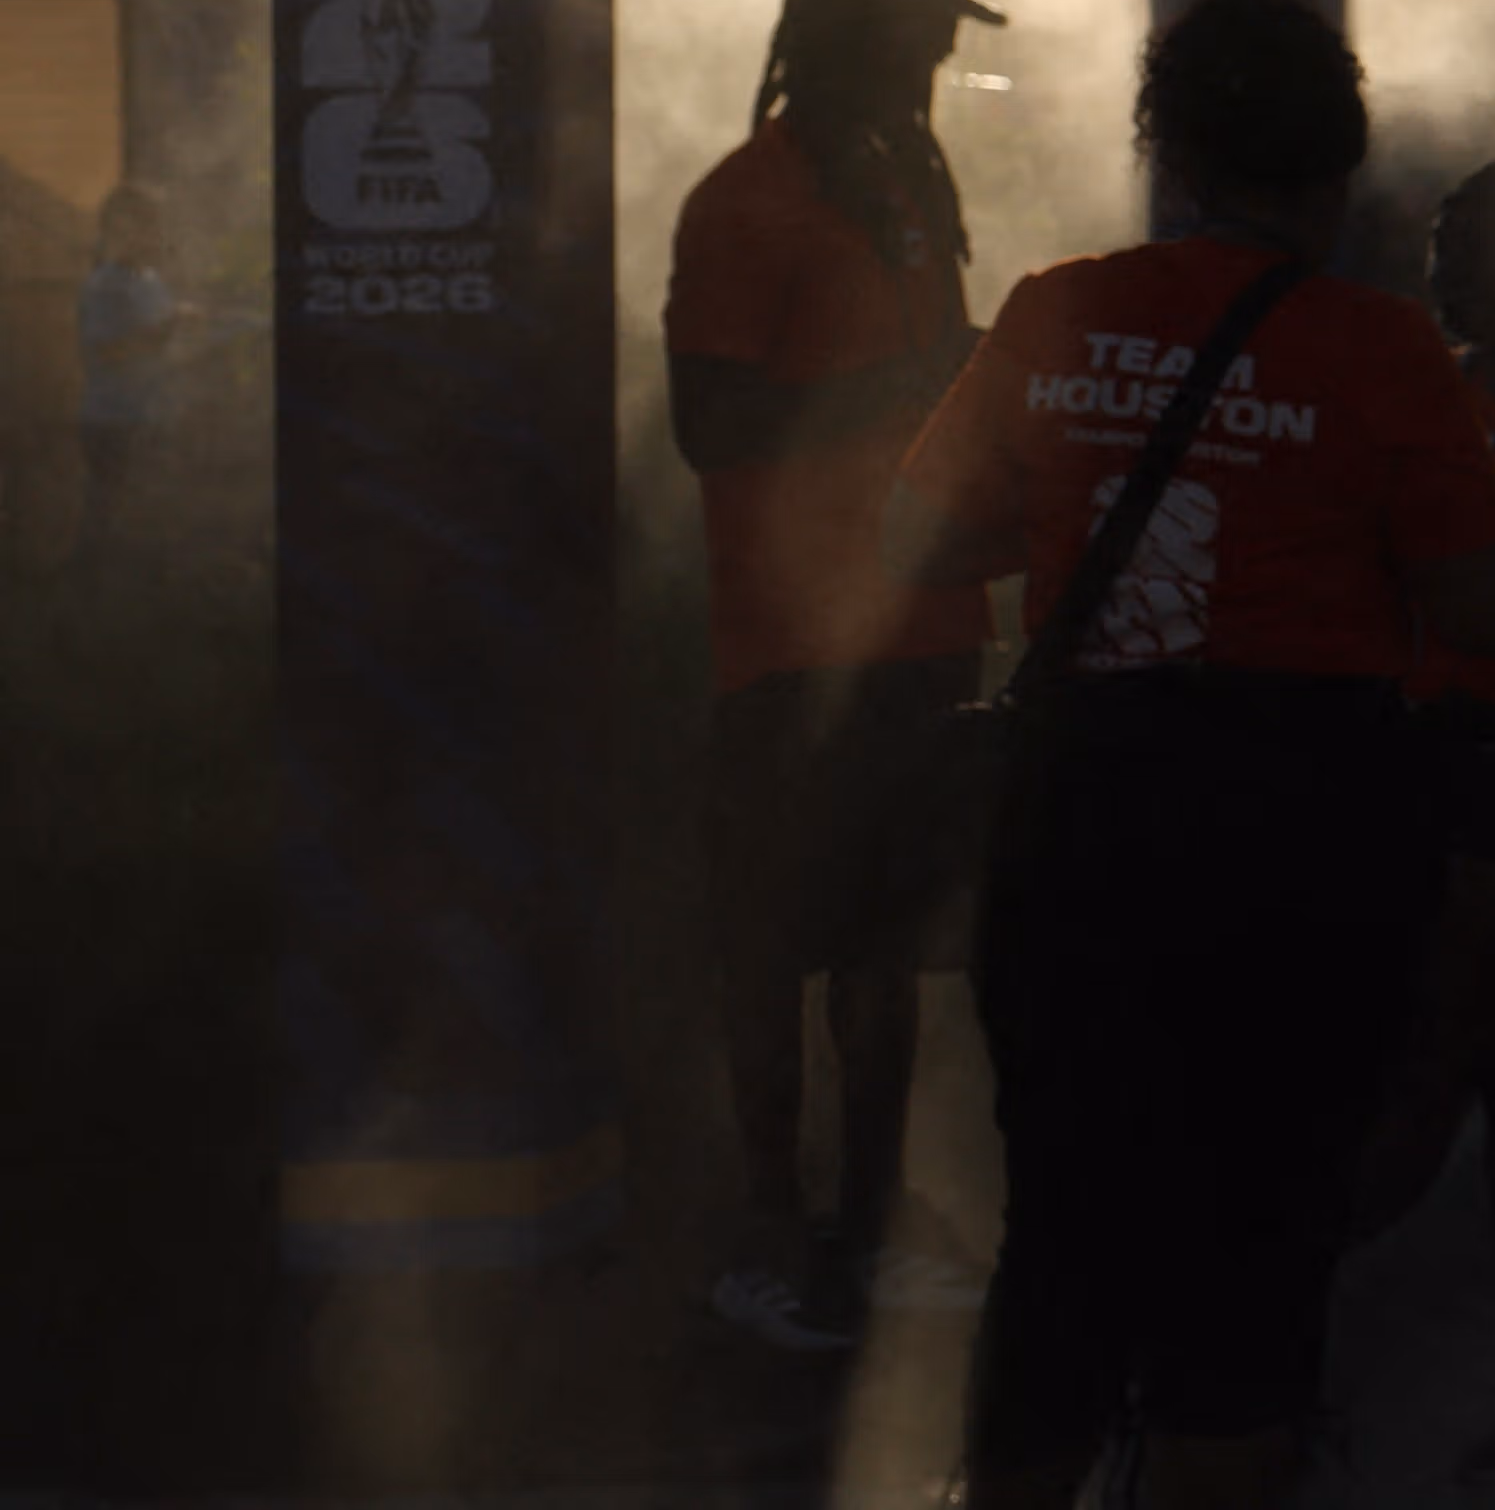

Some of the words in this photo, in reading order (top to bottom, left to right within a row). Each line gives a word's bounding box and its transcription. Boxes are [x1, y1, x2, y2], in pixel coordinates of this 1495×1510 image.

[357, 174, 443, 205] FIFA
[303, 274, 495, 315] 2026
[1025, 373, 1319, 443] HOUSON
